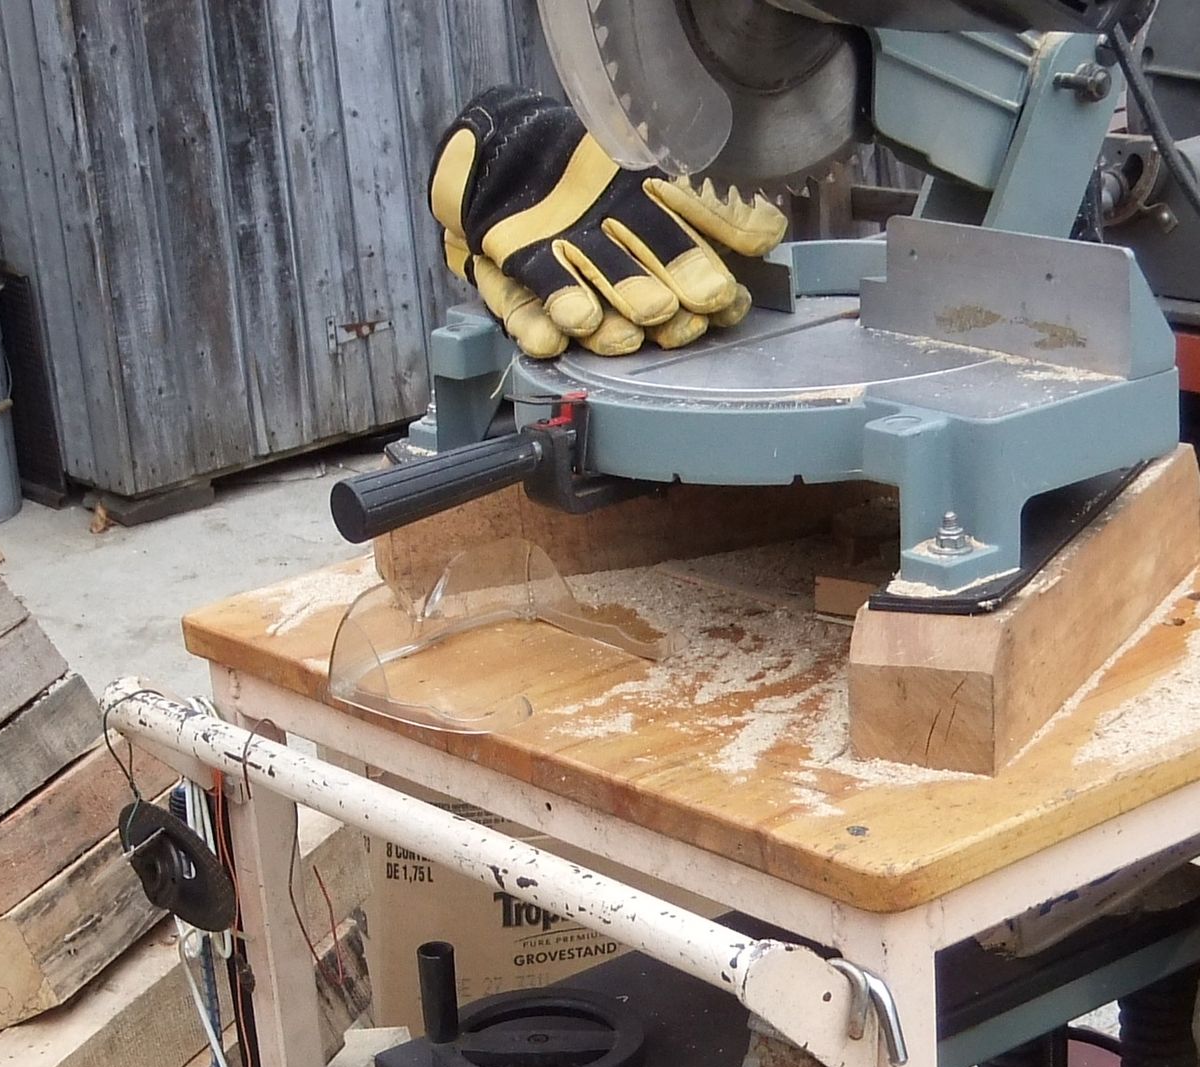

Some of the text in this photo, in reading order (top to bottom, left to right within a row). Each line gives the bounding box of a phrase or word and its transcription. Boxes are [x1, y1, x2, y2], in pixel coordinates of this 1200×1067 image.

[386, 842, 393, 858] 8
[386, 862, 434, 884] DE 1,75 L
[522, 930, 603, 949] PURE PREMIU
[513, 941, 617, 967] GROVESTAND
